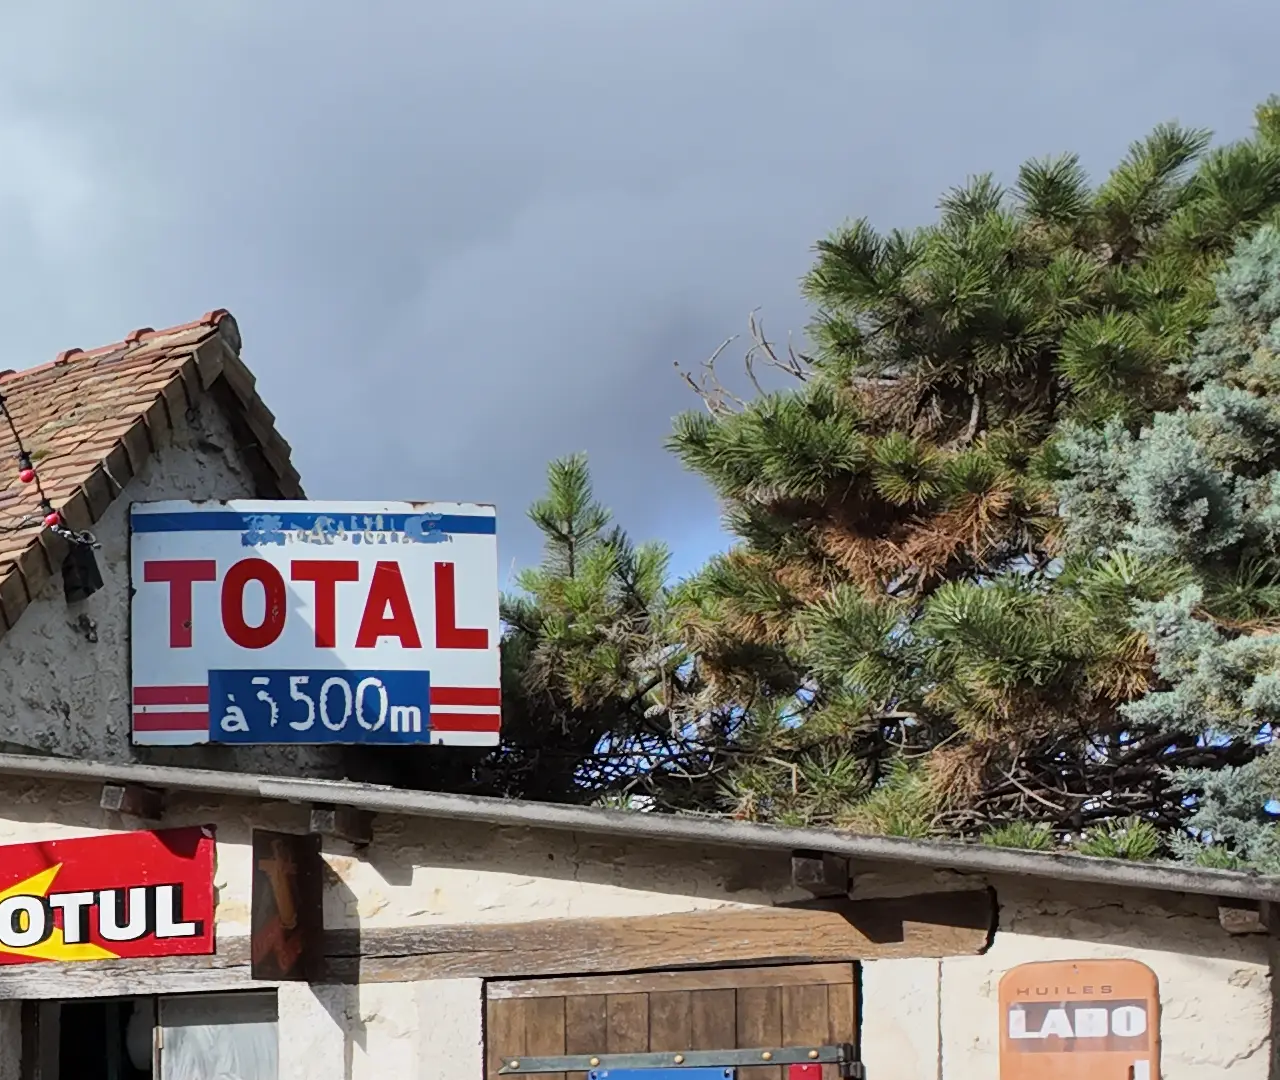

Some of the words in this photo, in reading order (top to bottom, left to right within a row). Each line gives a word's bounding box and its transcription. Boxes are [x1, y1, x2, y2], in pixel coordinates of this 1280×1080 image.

[144, 557, 489, 649] TOTAL
[220, 693, 249, 732] à
[1016, 985, 1113, 996] HUILES
[1009, 1006, 1147, 1039] LABO
